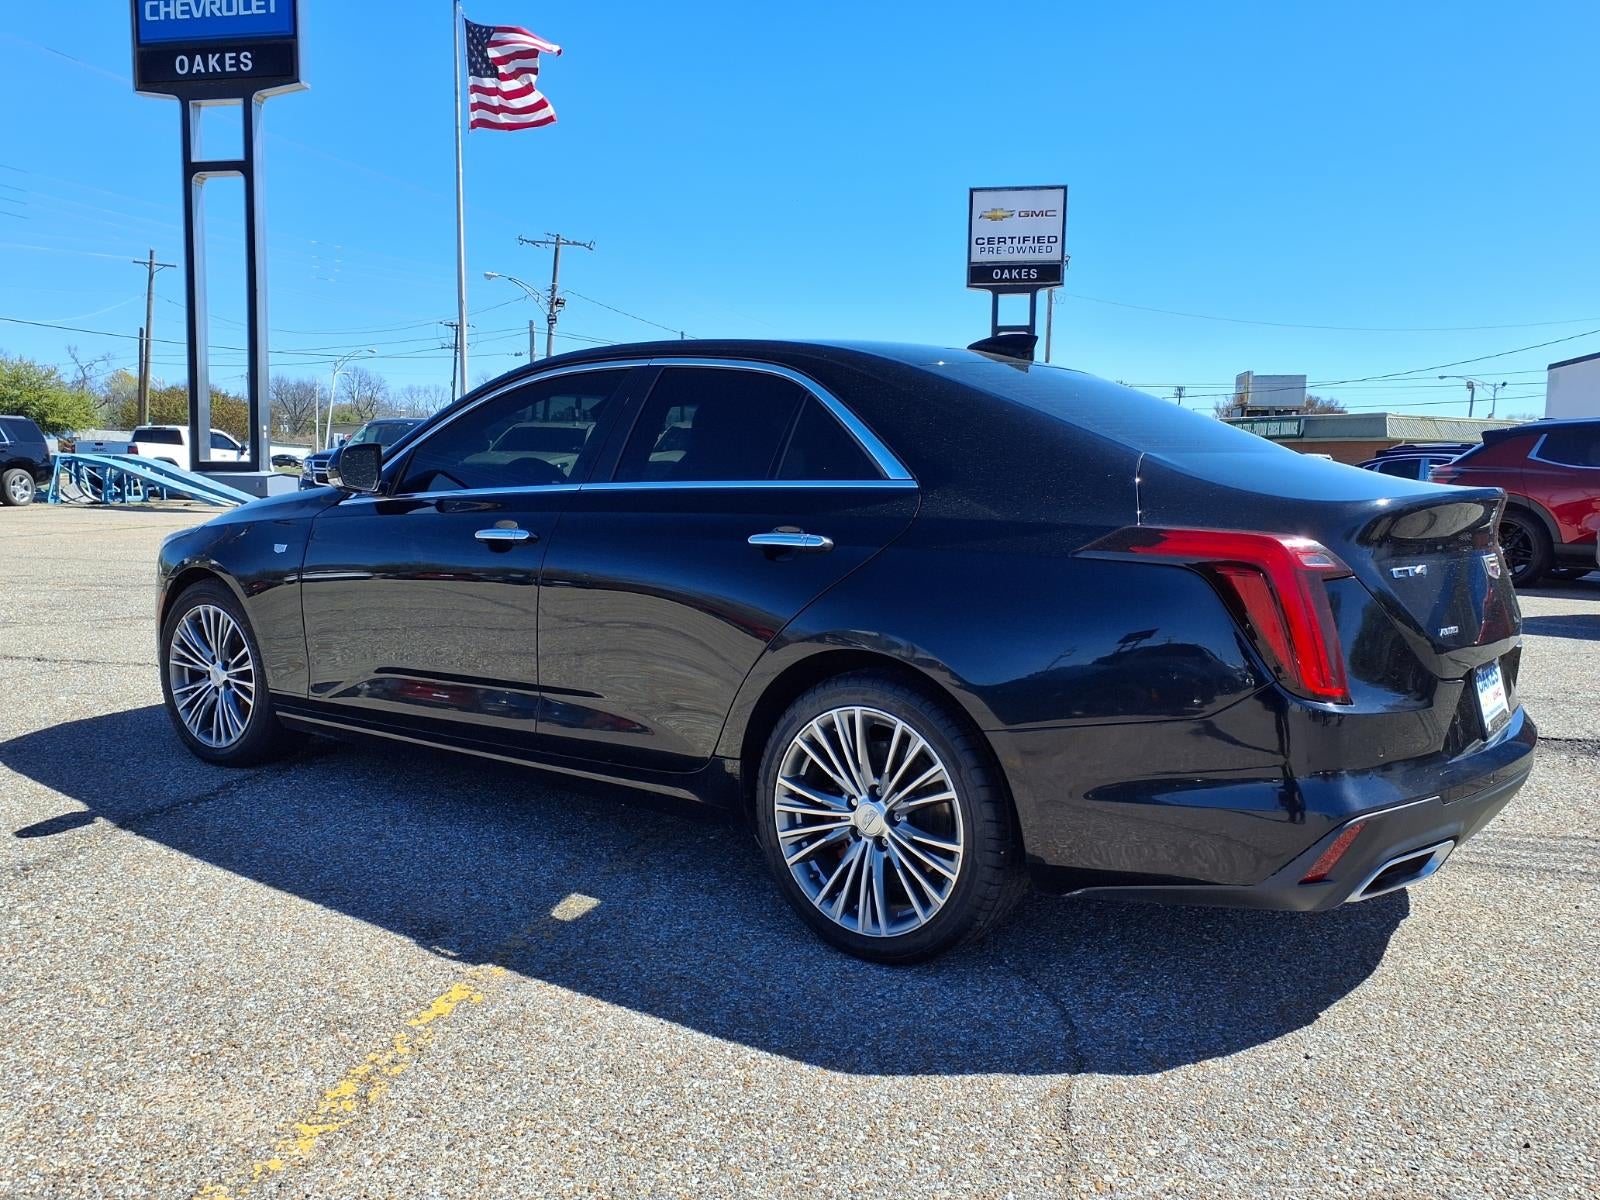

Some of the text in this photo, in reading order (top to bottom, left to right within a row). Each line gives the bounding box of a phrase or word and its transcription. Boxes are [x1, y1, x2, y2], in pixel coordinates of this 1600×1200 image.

[175, 51, 253, 75] OAKES
[1018, 210, 1057, 218] GMC
[975, 235, 1058, 246] CERTIFIED
[979, 245, 1053, 255] PRE-OWNED
[992, 268, 1038, 280] OAKES
[1390, 564, 1427, 578] CT4
